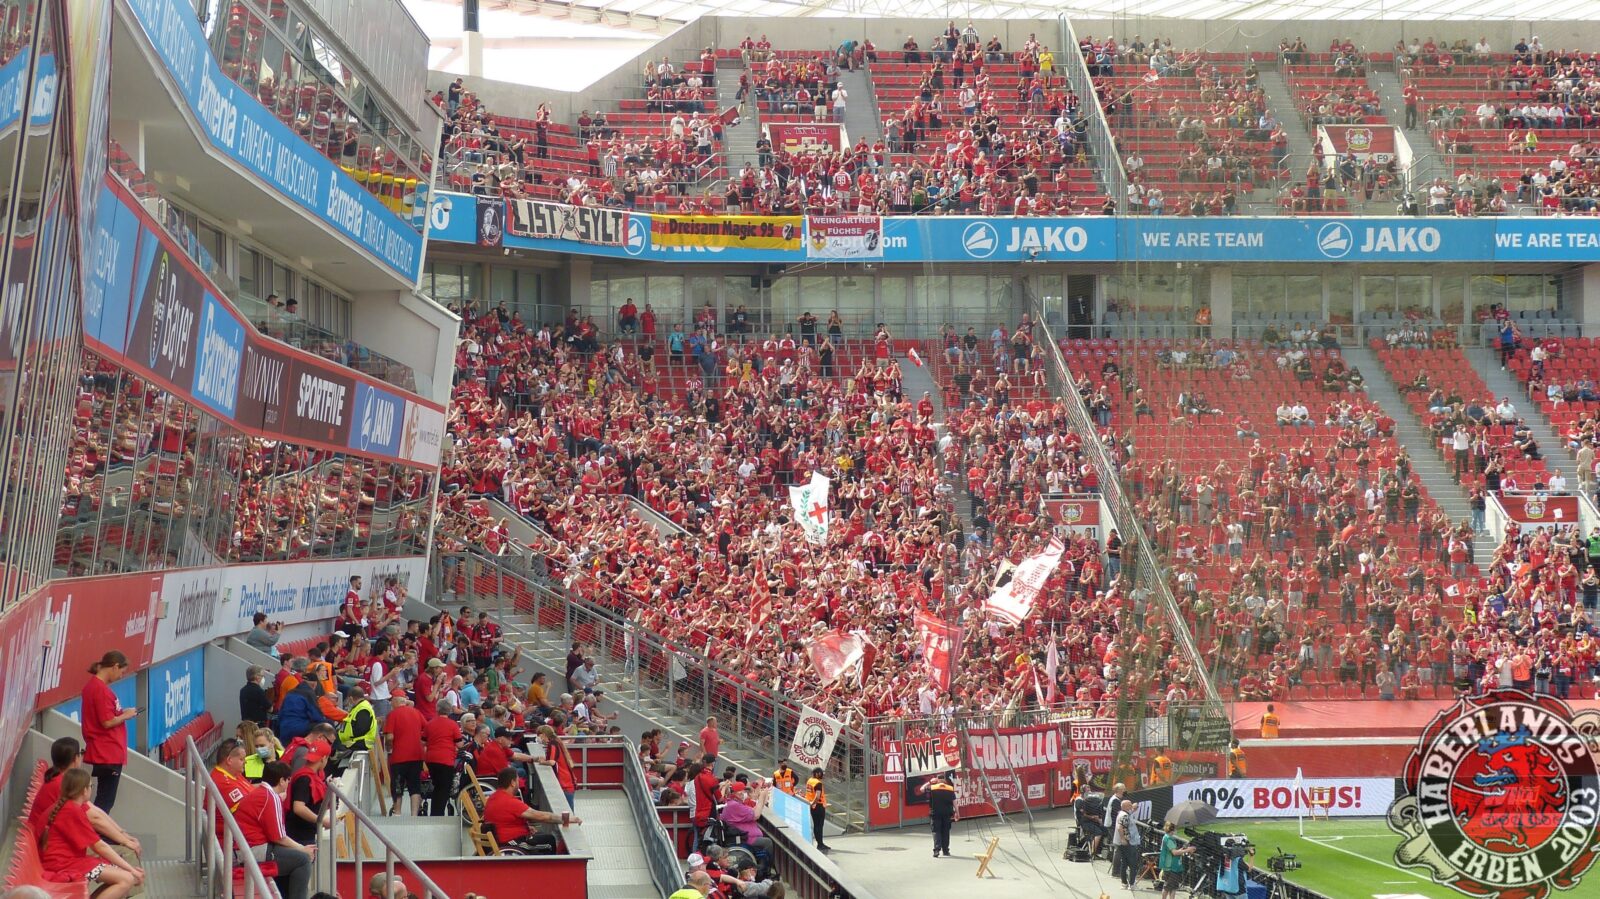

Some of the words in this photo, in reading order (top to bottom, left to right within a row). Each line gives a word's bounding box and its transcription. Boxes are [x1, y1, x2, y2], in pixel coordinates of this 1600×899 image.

[198, 50, 237, 148] Barmenia
[238, 115, 273, 176] EINFACH.
[274, 142, 319, 207] MENSCHLICH.
[326, 171, 363, 237] Barmenia
[511, 199, 557, 235] LIST
[579, 207, 622, 242] SYLT
[669, 219, 719, 235] Dreisam
[722, 221, 757, 241] Magic
[761, 222, 774, 237] 95
[827, 227, 862, 235] FÜCHSE
[1007, 226, 1088, 251] JAKO
[1143, 232, 1170, 247] WE
[1175, 232, 1210, 247] ARE
[1214, 232, 1263, 247] TEAM
[1361, 227, 1440, 252] JAKO
[1495, 233, 1522, 247] WE
[1527, 233, 1562, 248] ARE
[1566, 233, 1600, 248] TEA
[162, 272, 194, 380] Bayer
[198, 302, 240, 411] Barmenia
[297, 372, 346, 426] SPORTFIVE
[371, 398, 395, 447] JAKO
[1253, 786, 1361, 809] BONUS!
